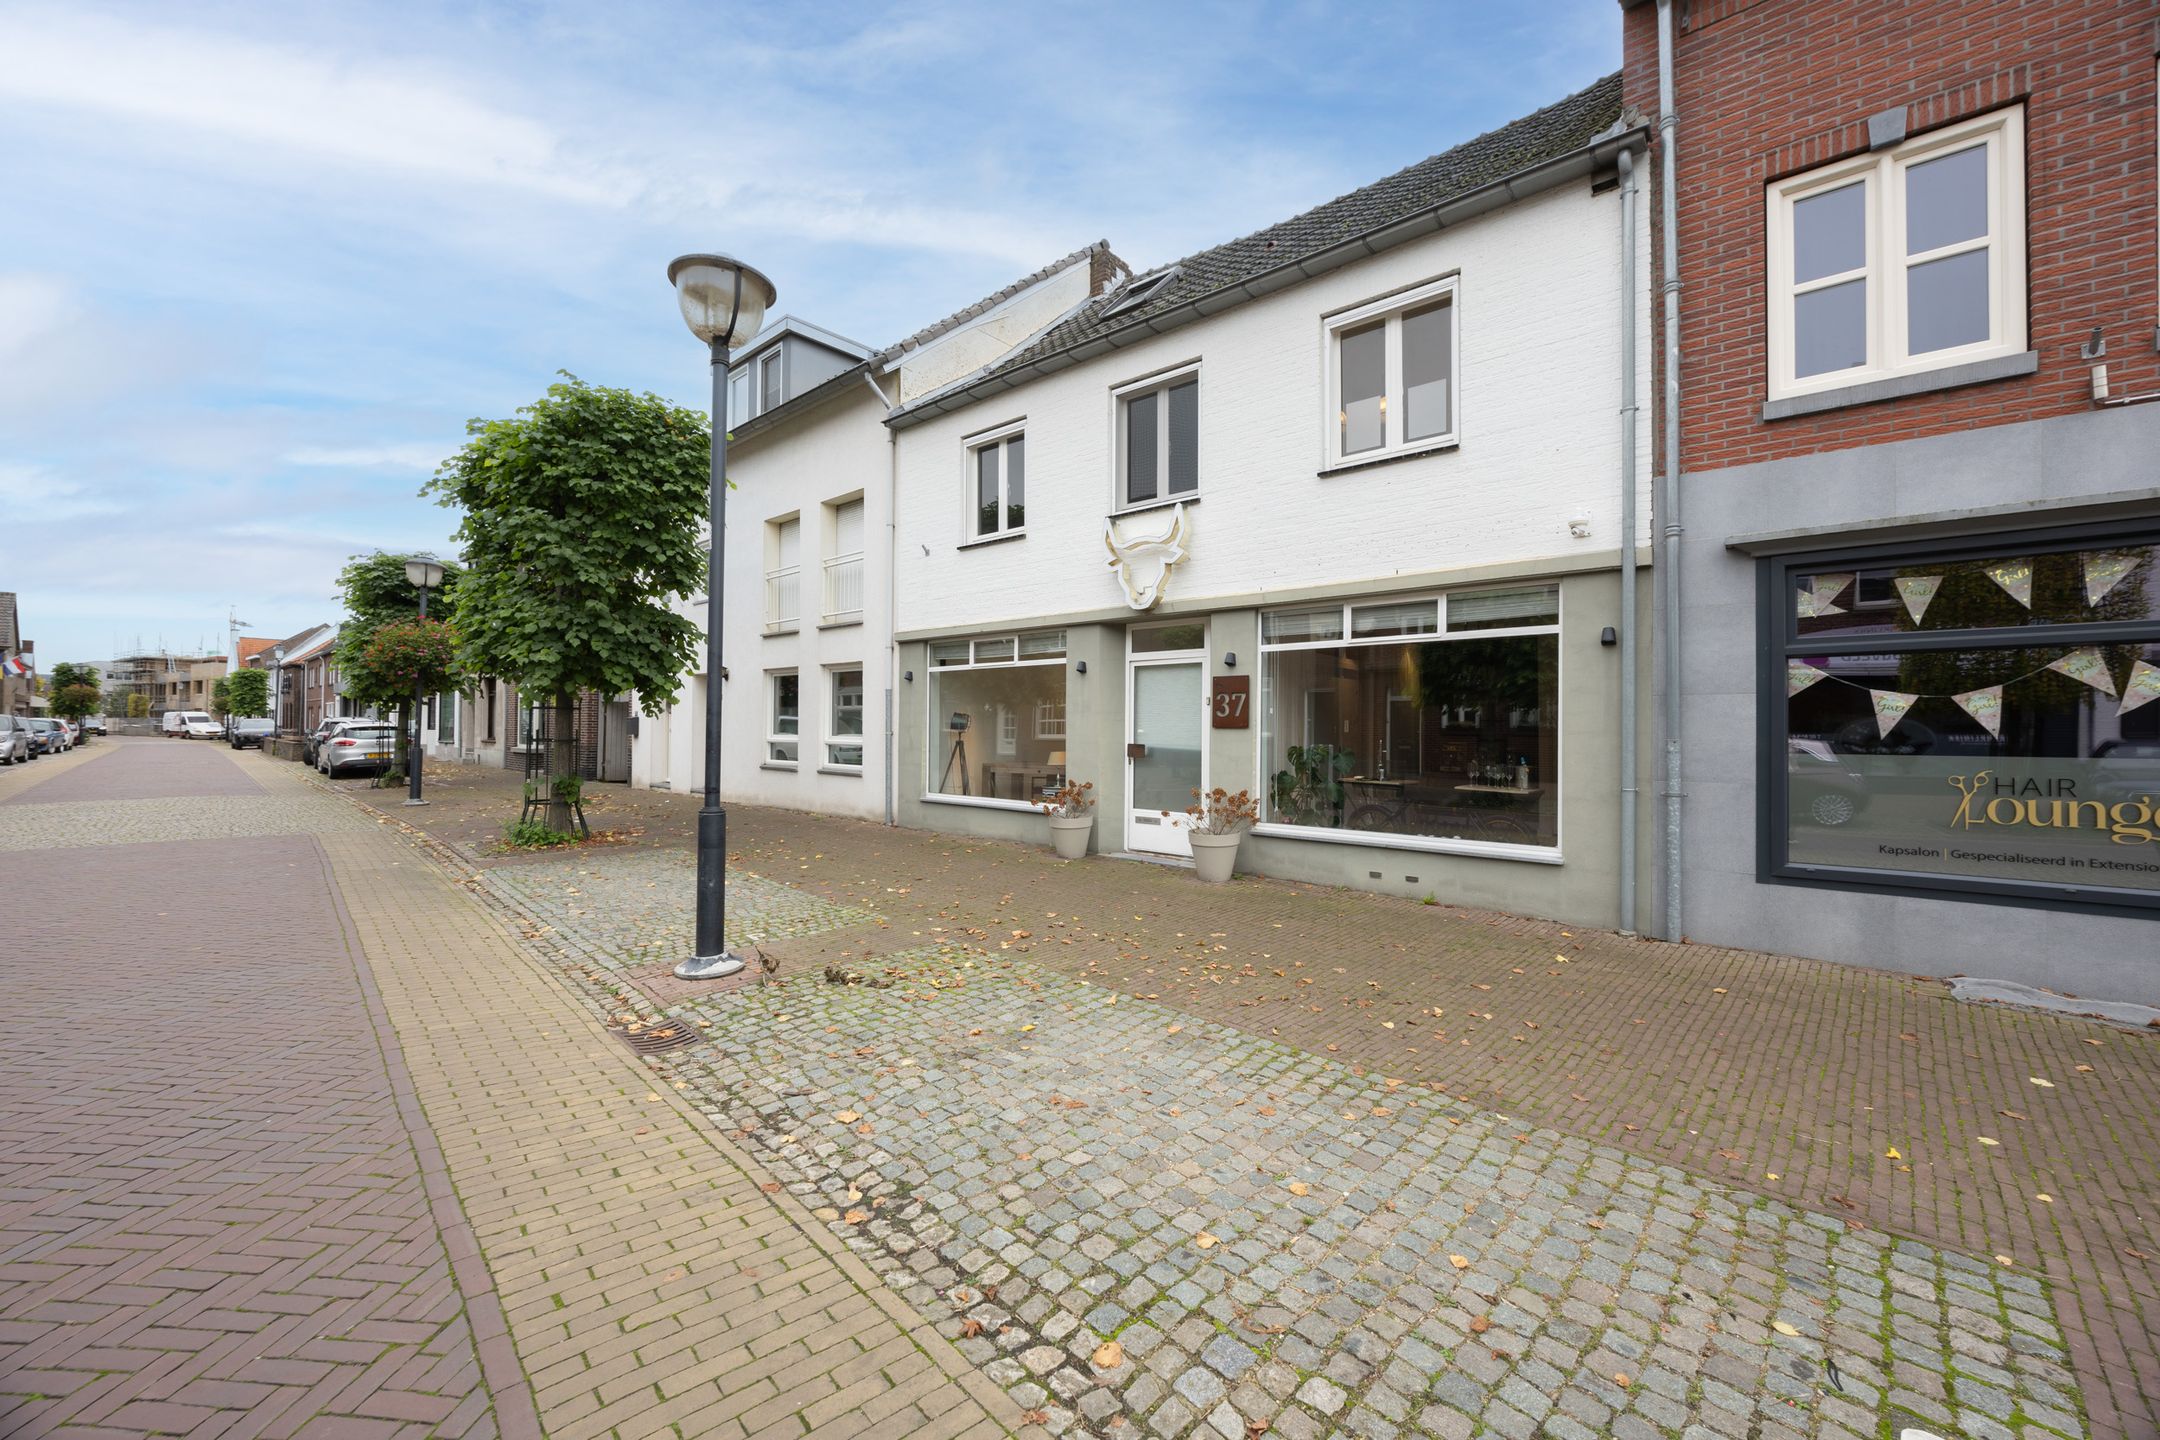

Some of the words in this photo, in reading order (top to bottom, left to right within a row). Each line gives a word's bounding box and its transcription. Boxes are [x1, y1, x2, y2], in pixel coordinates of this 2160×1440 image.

[1215, 692, 1247, 718] 37
[1994, 776, 2077, 798] HAIR
[1951, 788, 2160, 845] Loung
[1879, 844, 1940, 857] Kapsalon
[1950, 849, 2066, 867] Gespecialiseerd
[2071, 857, 2085, 868] in
